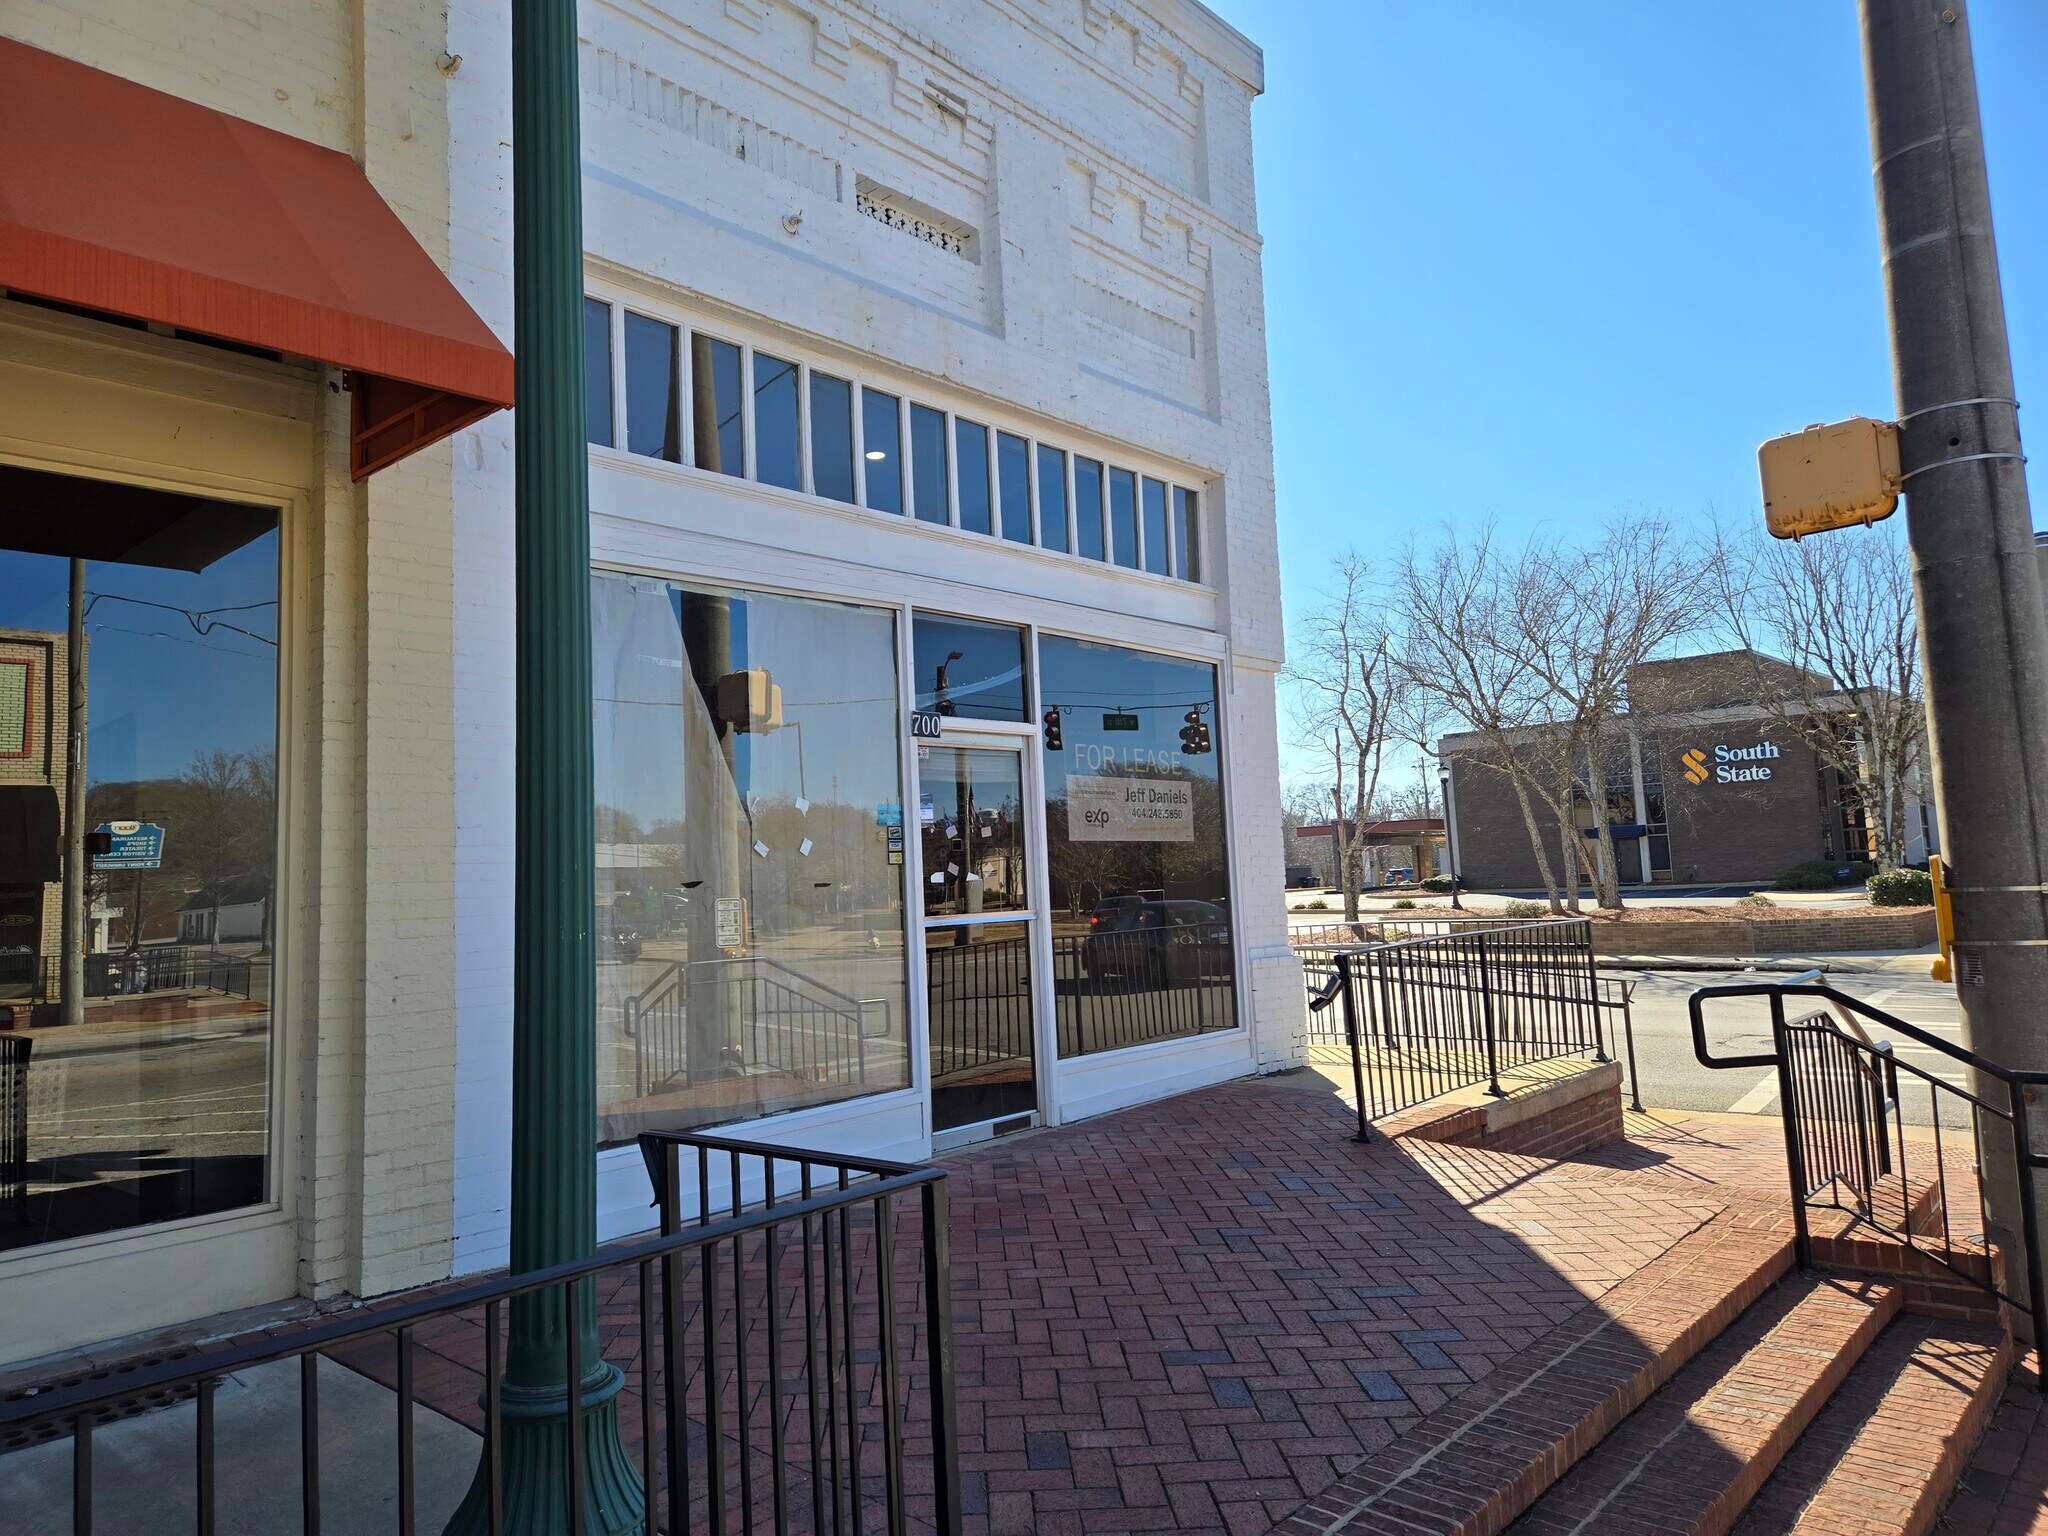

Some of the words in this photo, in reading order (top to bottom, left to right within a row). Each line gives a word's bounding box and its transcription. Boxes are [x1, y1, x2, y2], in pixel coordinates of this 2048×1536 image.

[912, 714, 940, 736] 700
[1074, 743, 1117, 773] FOR
[1122, 747, 1183, 775] LEASE
[1714, 740, 1780, 763] South
[1716, 764, 1771, 784] State
[1124, 787, 1146, 803] Jeff
[1148, 788, 1188, 804] Daniels
